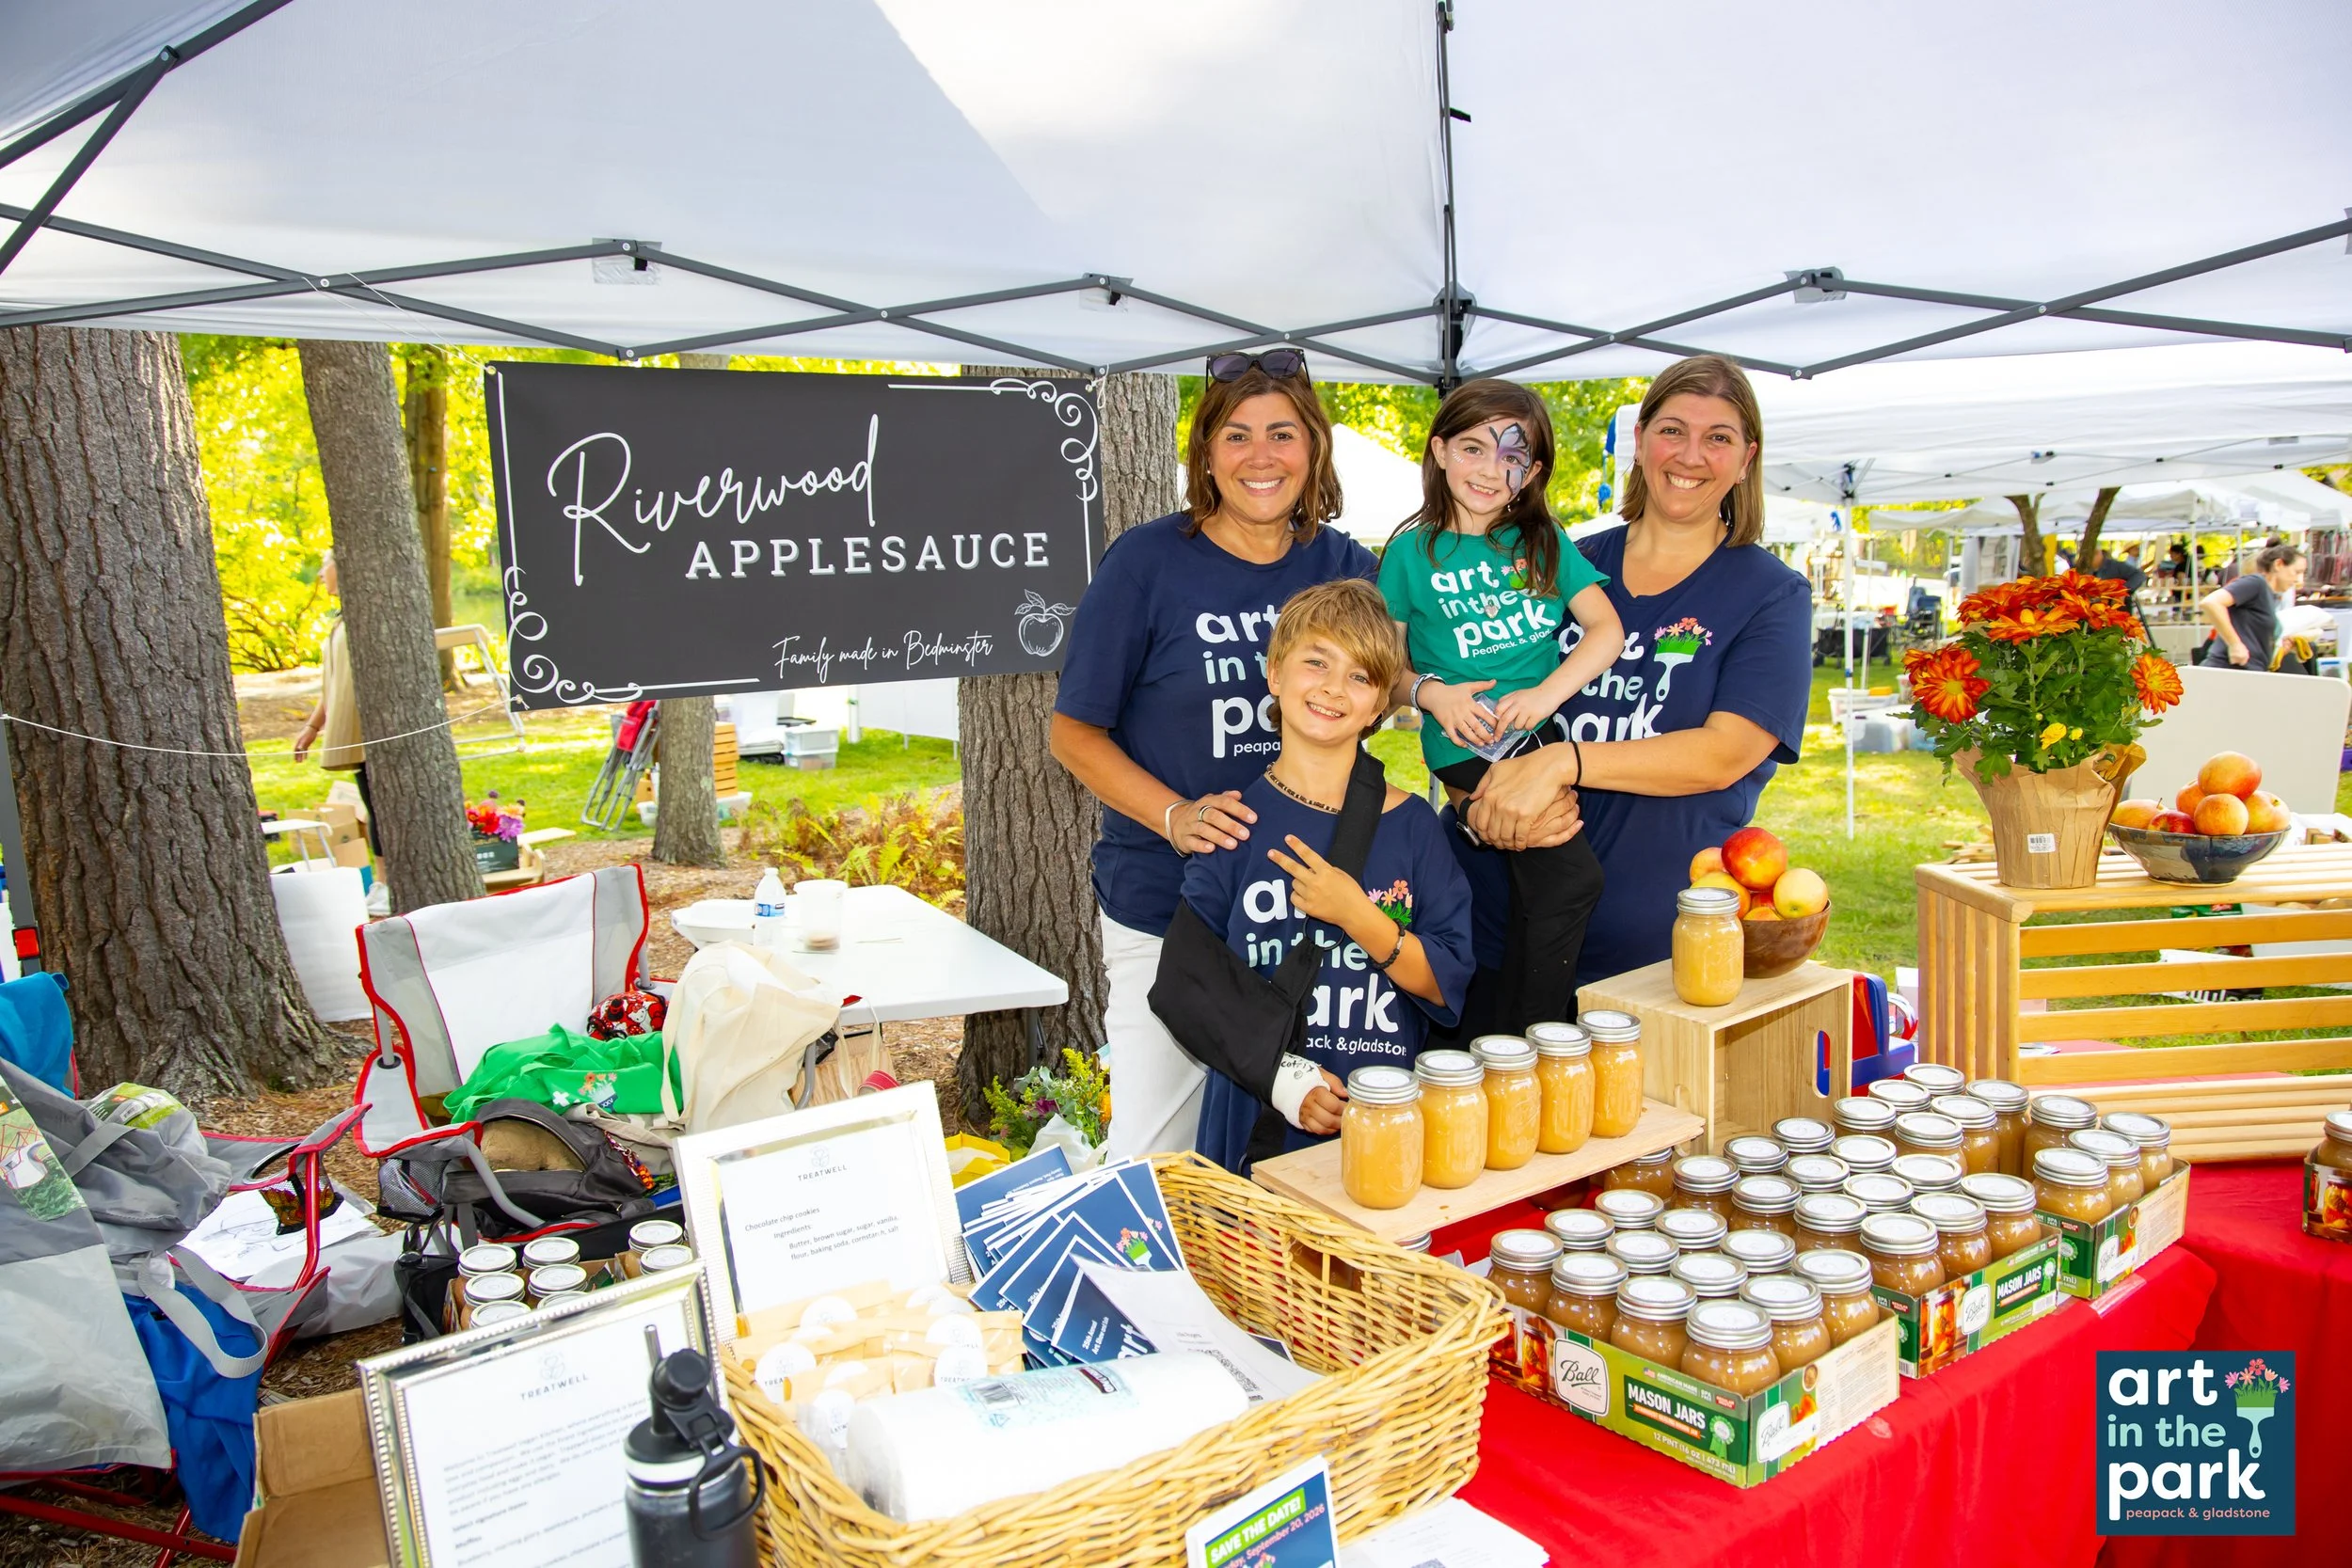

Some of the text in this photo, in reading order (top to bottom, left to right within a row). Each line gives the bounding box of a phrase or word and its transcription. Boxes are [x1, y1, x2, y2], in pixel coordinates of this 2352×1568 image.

[547, 413, 879, 586] Riverwood
[685, 531, 1050, 579] APPLESAUCE
[1431, 561, 1500, 594] art
[1438, 589, 1518, 620] in the
[1453, 599, 1556, 658] park
[772, 629, 993, 684] Family made in Bedminster
[1472, 641, 1518, 657] peapack
[1202, 650, 1247, 685] in
[1233, 740, 1280, 756] peapa
[1247, 932, 1282, 967] in
[1307, 973, 1398, 1033] ark
[1336, 1037, 1347, 1051] &
[798, 1164, 848, 1181] TREATWELL
[745, 1207, 819, 1231] Chocolate chip cookies
[773, 1224, 813, 1239] Ingredients:
[789, 1239, 812, 1250] Butter,
[813, 1233, 834, 1243] brown
[836, 1227, 855, 1238] sugar,
[856, 1222, 875, 1232] sugar,
[791, 1251, 809, 1261] flour,
[810, 1243, 833, 1257] baking
[1996, 1275, 2023, 1299] MASON
[2024, 1265, 2042, 1286] JARS
[520, 1374, 589, 1401] TREATWELL
[1561, 1360, 1601, 1387] Ball
[1628, 1383, 1671, 1414] MASON
[1675, 1402, 1706, 1430] JARS
[1654, 1432, 1661, 1441] 12
[1661, 1435, 1678, 1449] PINT
[1211, 1496, 1301, 1564] SAVE THE DATE!
[1246, 1527, 1290, 1560] September
[1290, 1517, 1303, 1532] 20,
[1304, 1503, 1326, 1523] 2026
